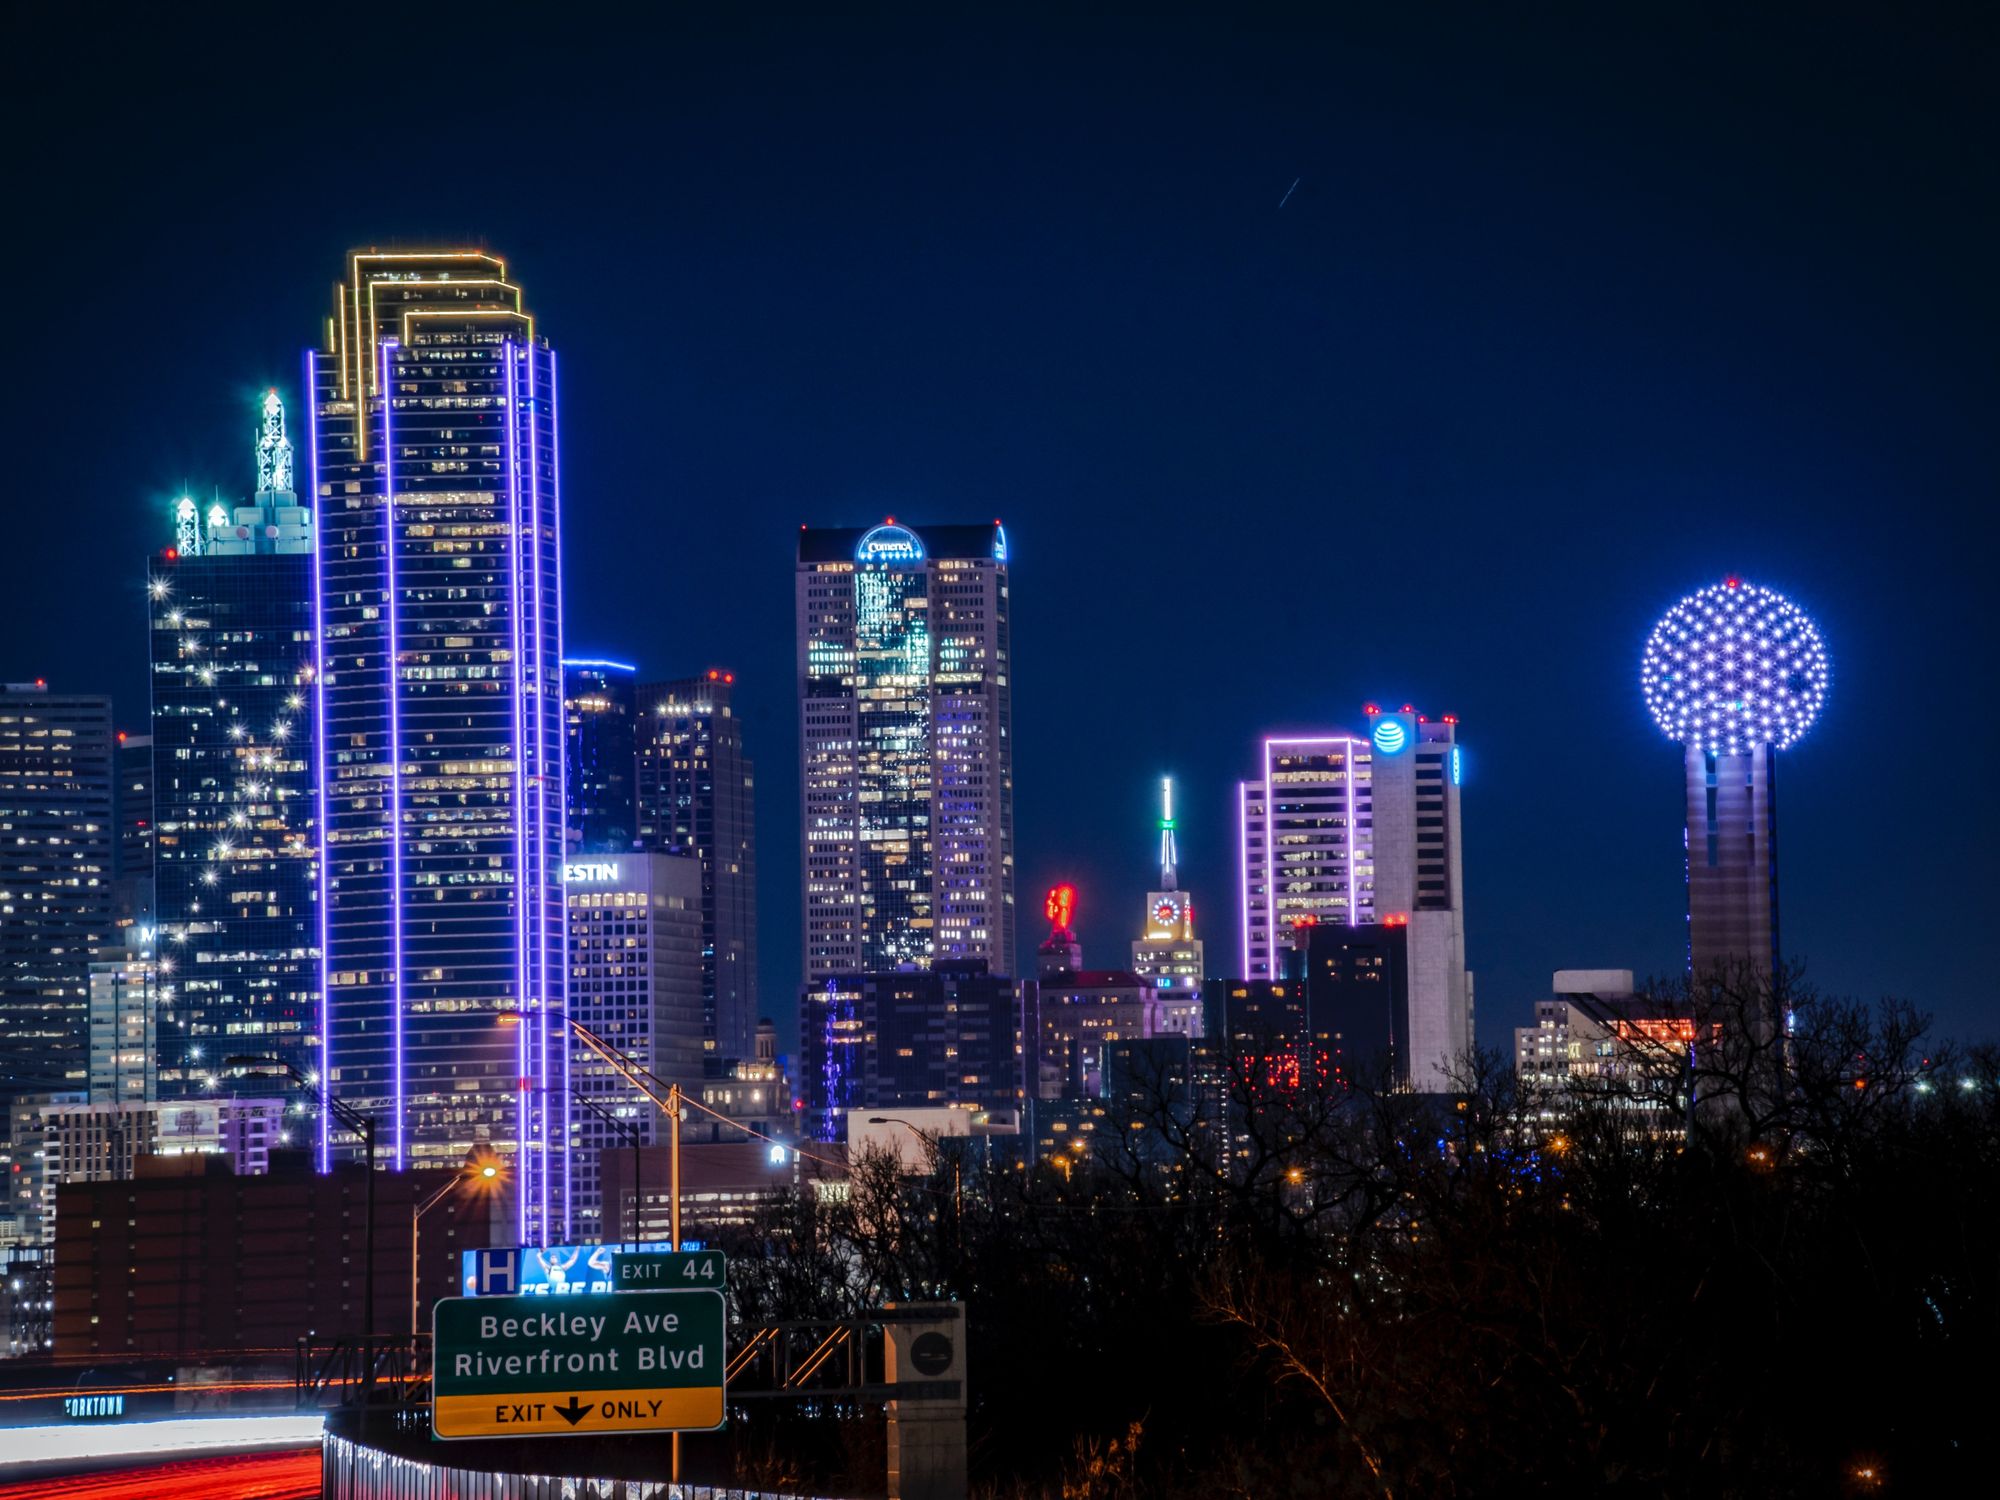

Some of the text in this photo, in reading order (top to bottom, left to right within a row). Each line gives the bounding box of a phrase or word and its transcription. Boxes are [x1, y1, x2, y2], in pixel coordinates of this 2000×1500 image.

[483, 1251, 515, 1292] H
[622, 1259, 715, 1280] EXIT 44
[480, 1311, 680, 1342] Beckley Ave
[455, 1344, 704, 1377] Riverfront Blvd
[65, 1396, 123, 1416] YORKTOWN
[495, 1400, 663, 1423] EXIT ONLY
